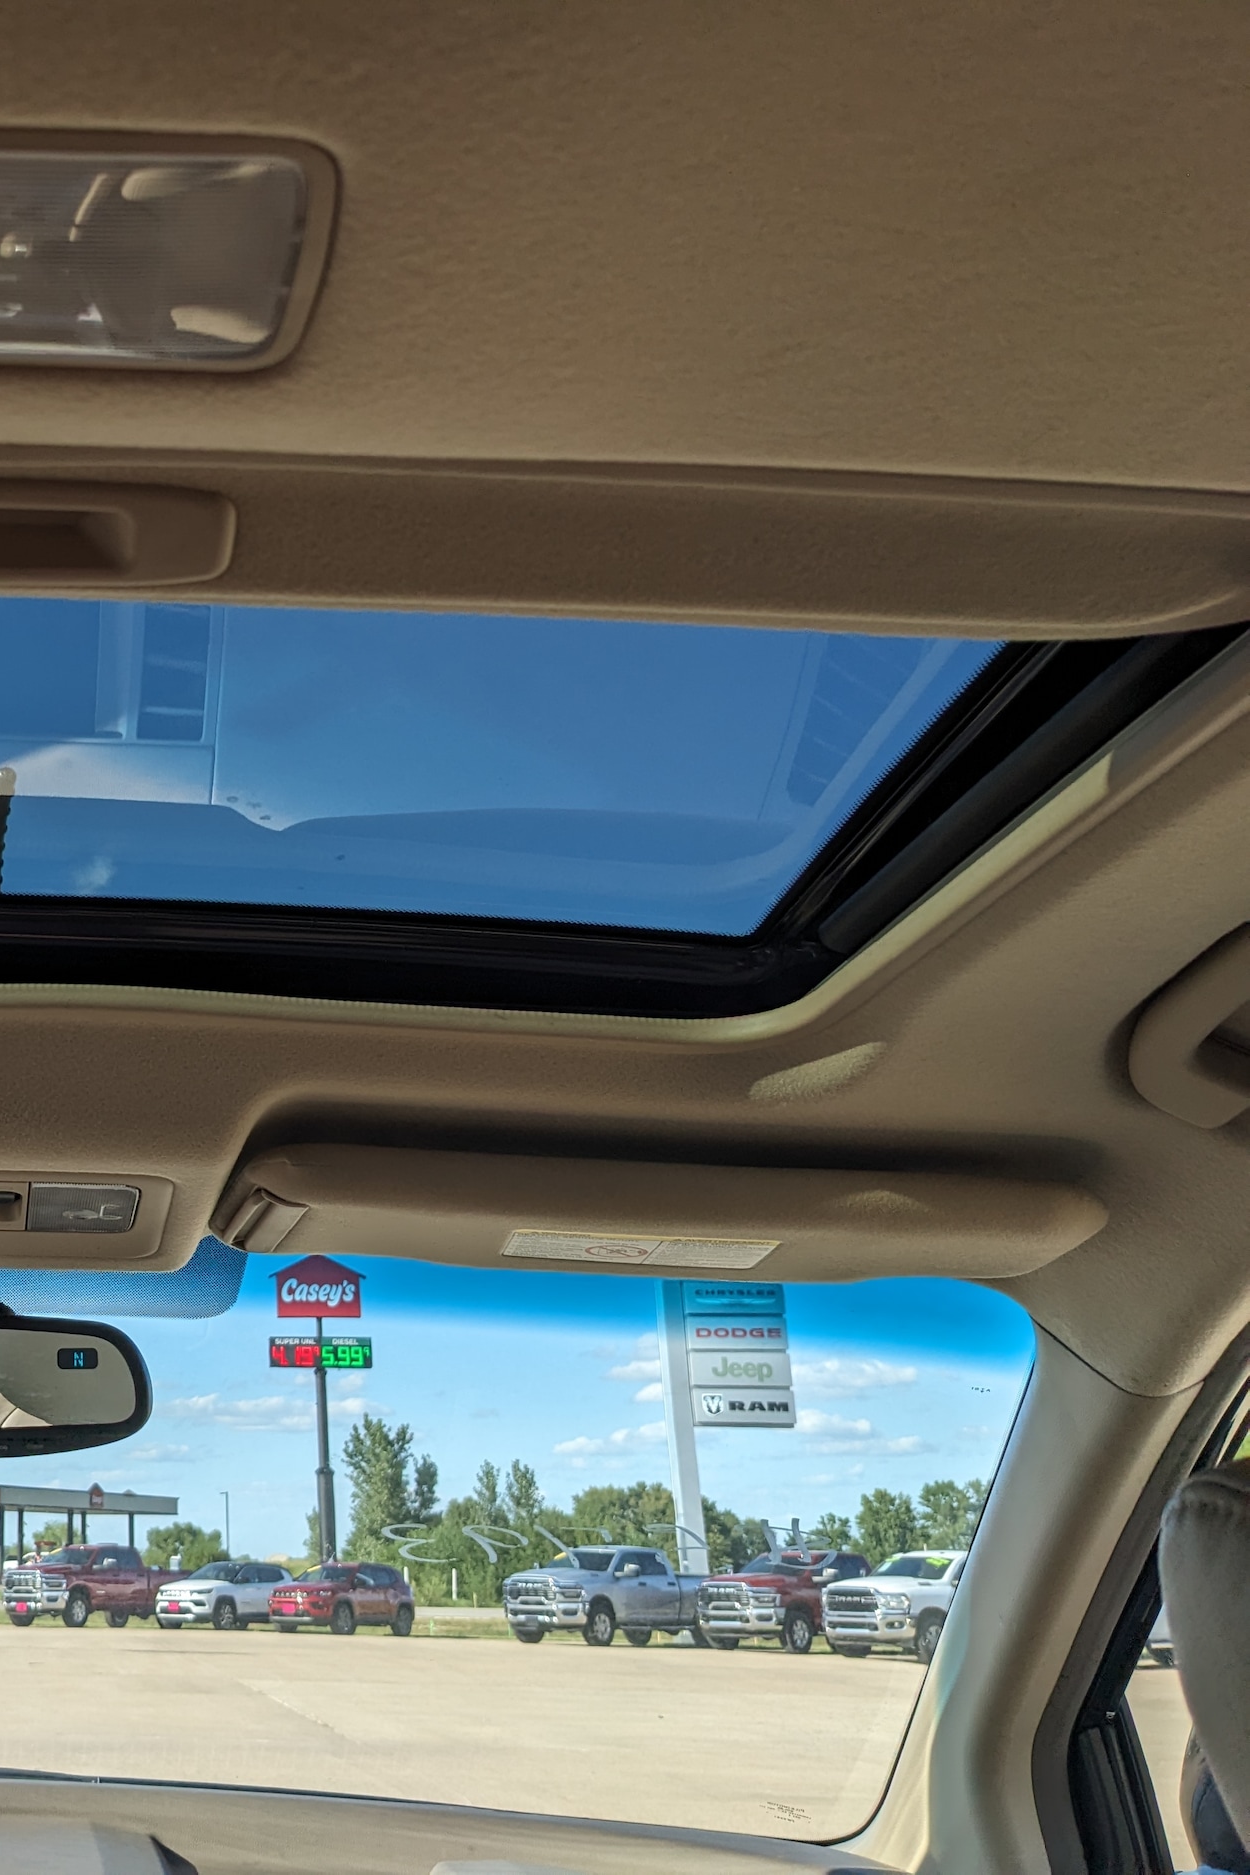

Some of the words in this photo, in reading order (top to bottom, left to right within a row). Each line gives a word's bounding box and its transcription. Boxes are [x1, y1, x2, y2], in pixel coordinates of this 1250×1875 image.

[280, 1277, 356, 1308] Casey's
[694, 1288, 777, 1297] CHRYSLER
[695, 1327, 783, 1339] DODGE
[73, 1351, 84, 1367] N
[711, 1356, 774, 1382] Jeep
[728, 1400, 790, 1413] RAM
